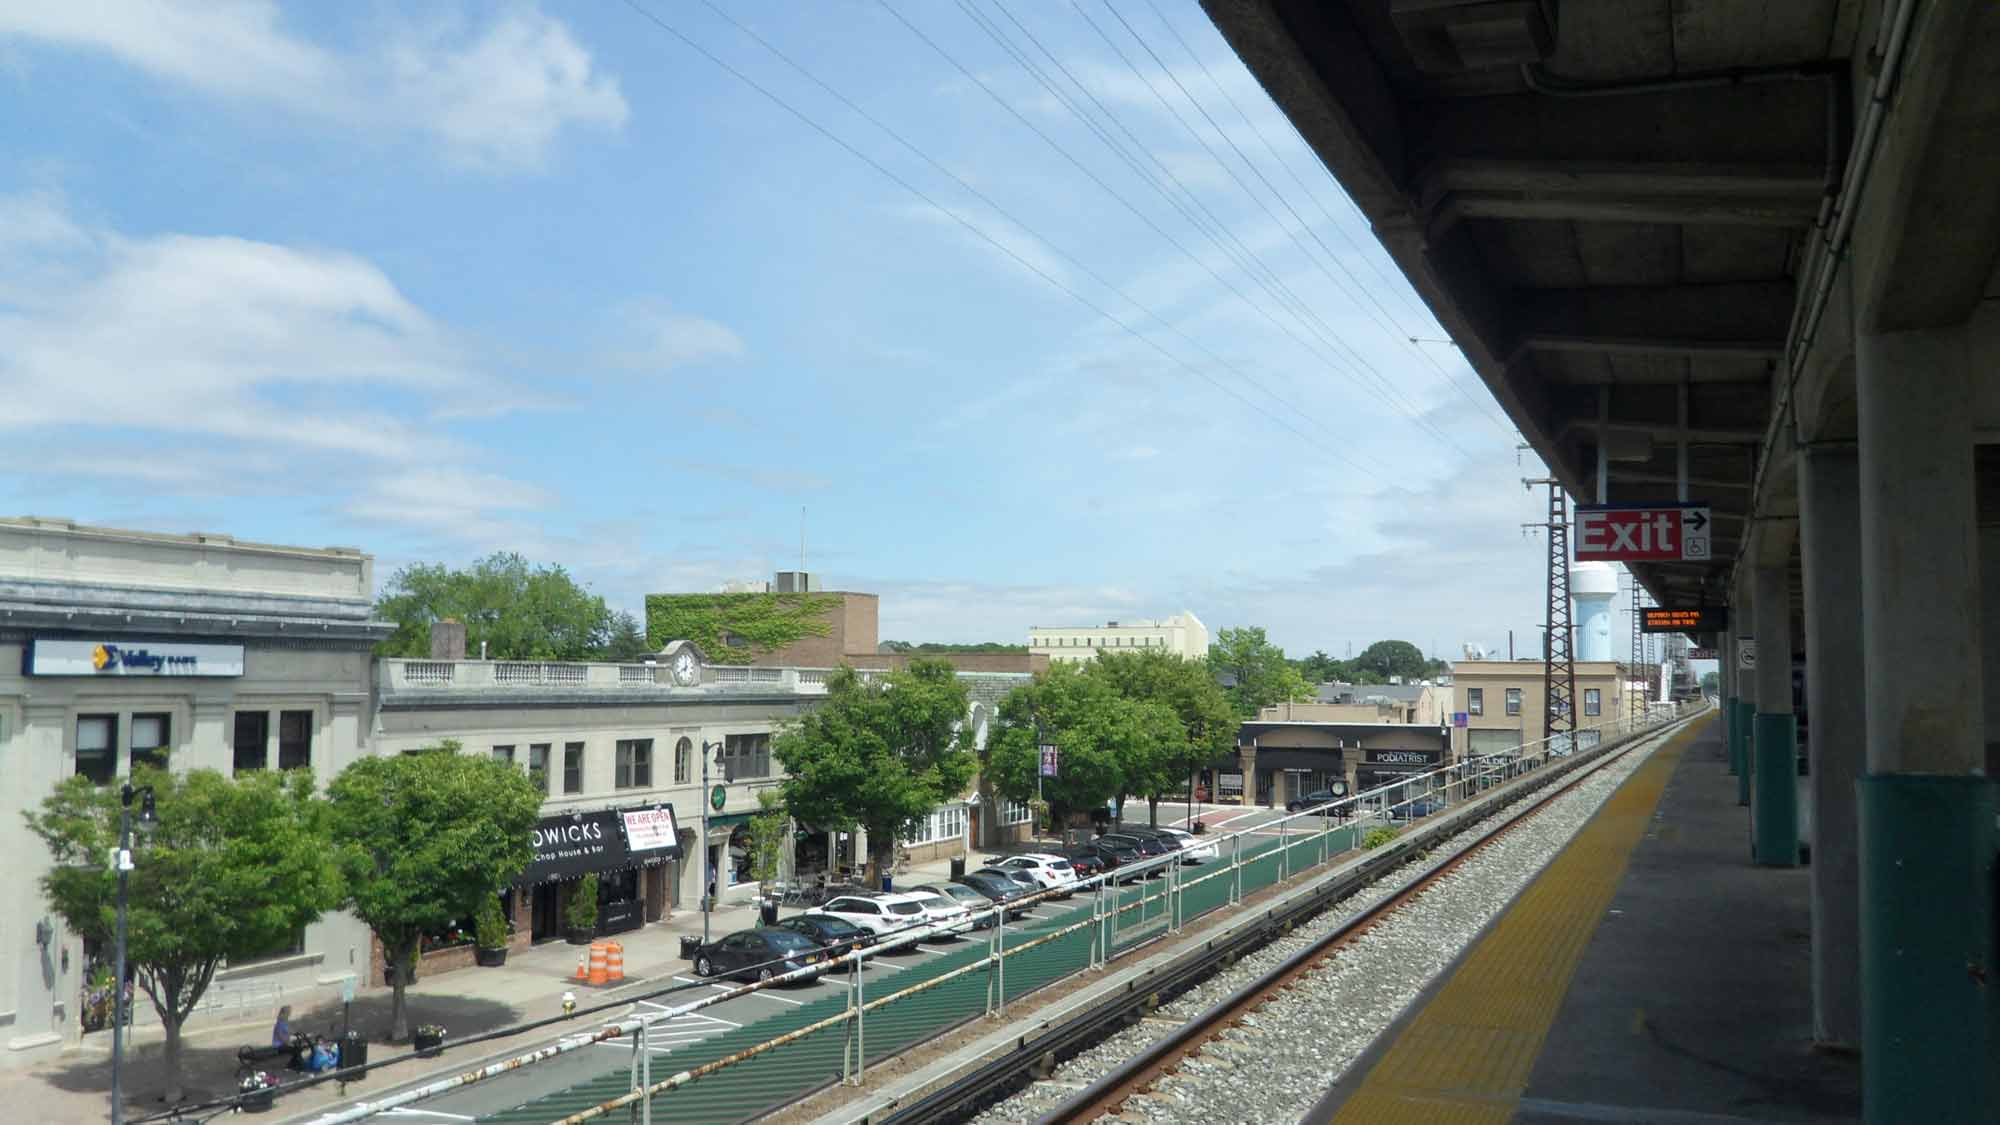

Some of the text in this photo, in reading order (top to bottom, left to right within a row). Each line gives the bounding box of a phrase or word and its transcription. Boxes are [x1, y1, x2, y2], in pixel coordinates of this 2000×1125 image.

[1576, 512, 1673, 552] Exit
[121, 649, 165, 672] Valley
[1377, 752, 1427, 763] PODIATRIST
[626, 811, 671, 825] WE ARE OPEN
[558, 847, 582, 857] House
[591, 845, 604, 854] Bar
